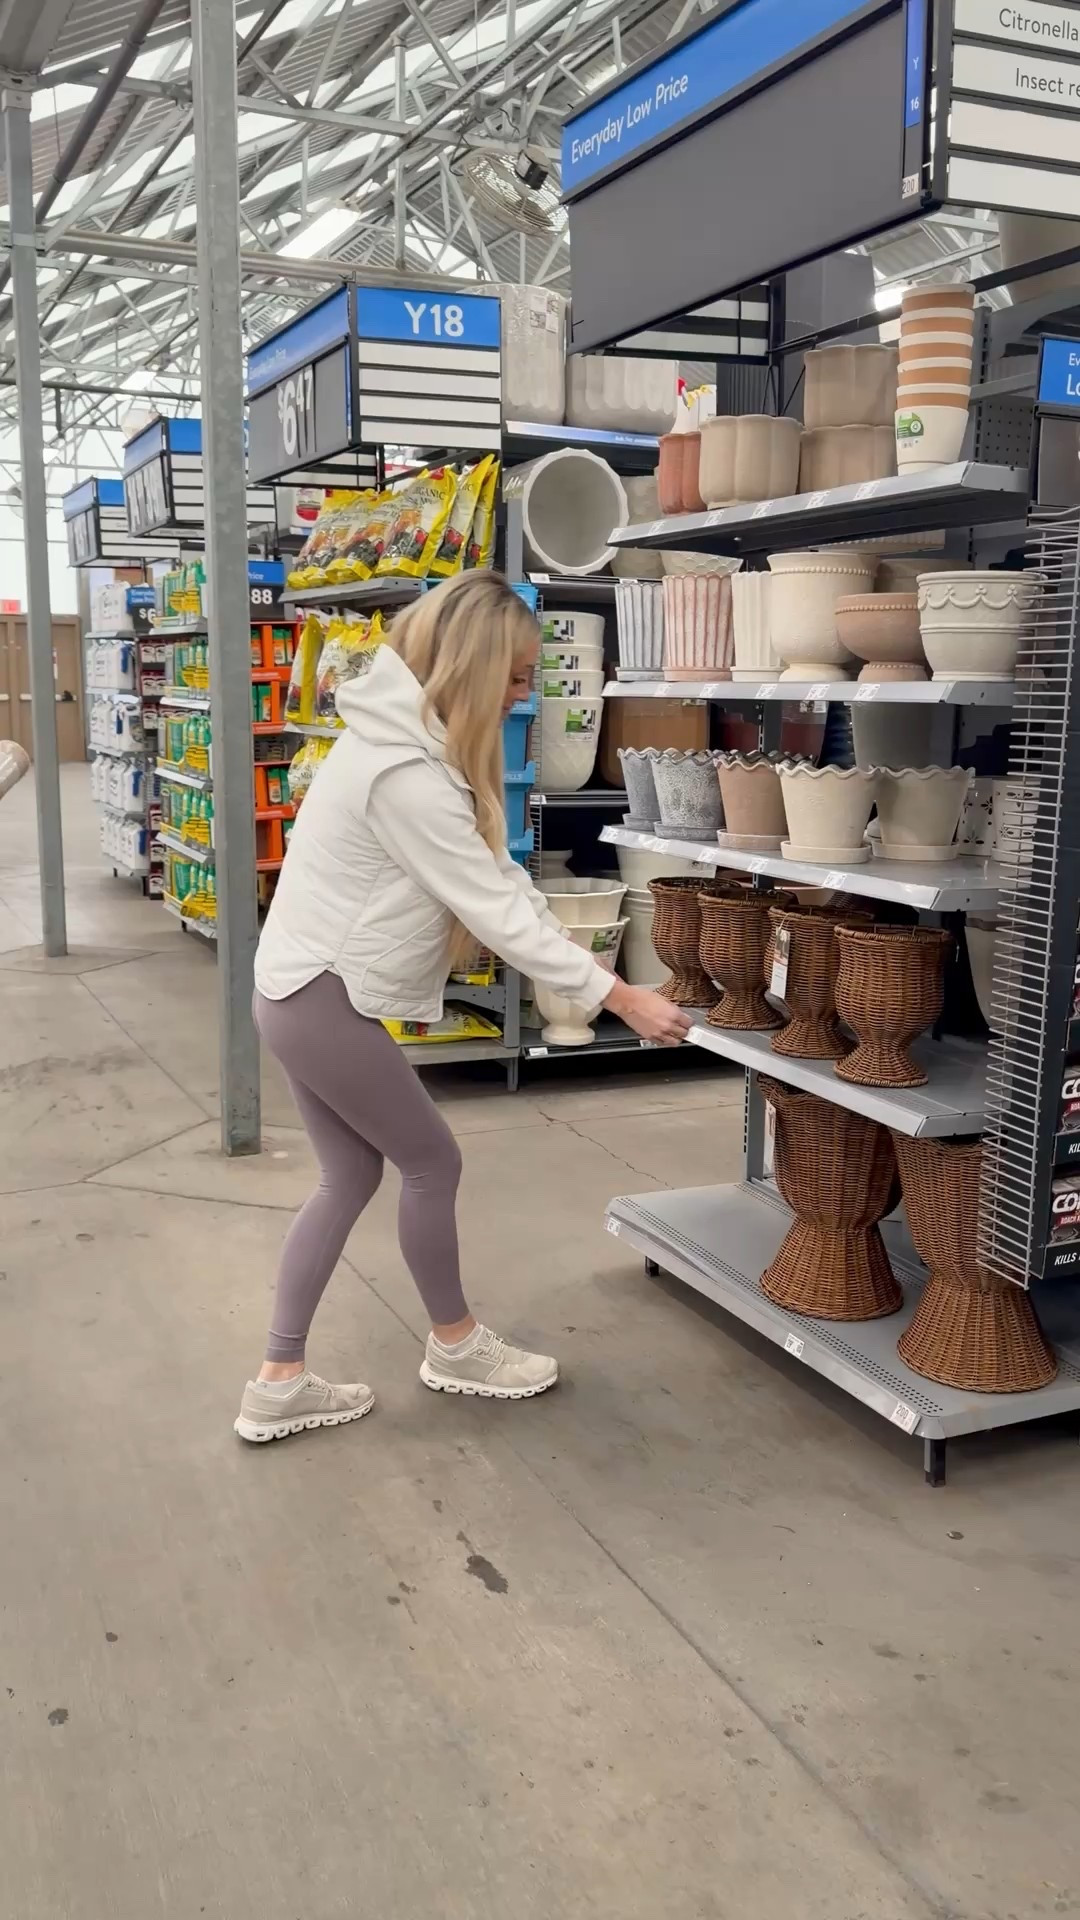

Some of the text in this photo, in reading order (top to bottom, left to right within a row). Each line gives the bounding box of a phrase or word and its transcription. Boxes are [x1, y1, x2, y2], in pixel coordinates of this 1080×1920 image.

[998, 7, 1079, 41] Citronella
[912, 56, 920, 71] Y
[1015, 67, 1064, 95] Insect
[910, 96, 920, 112] 16
[571, 74, 689, 164] Everyday Low Price
[403, 300, 465, 338] Y18
[1054, 1252, 1077, 1267] KILLS
